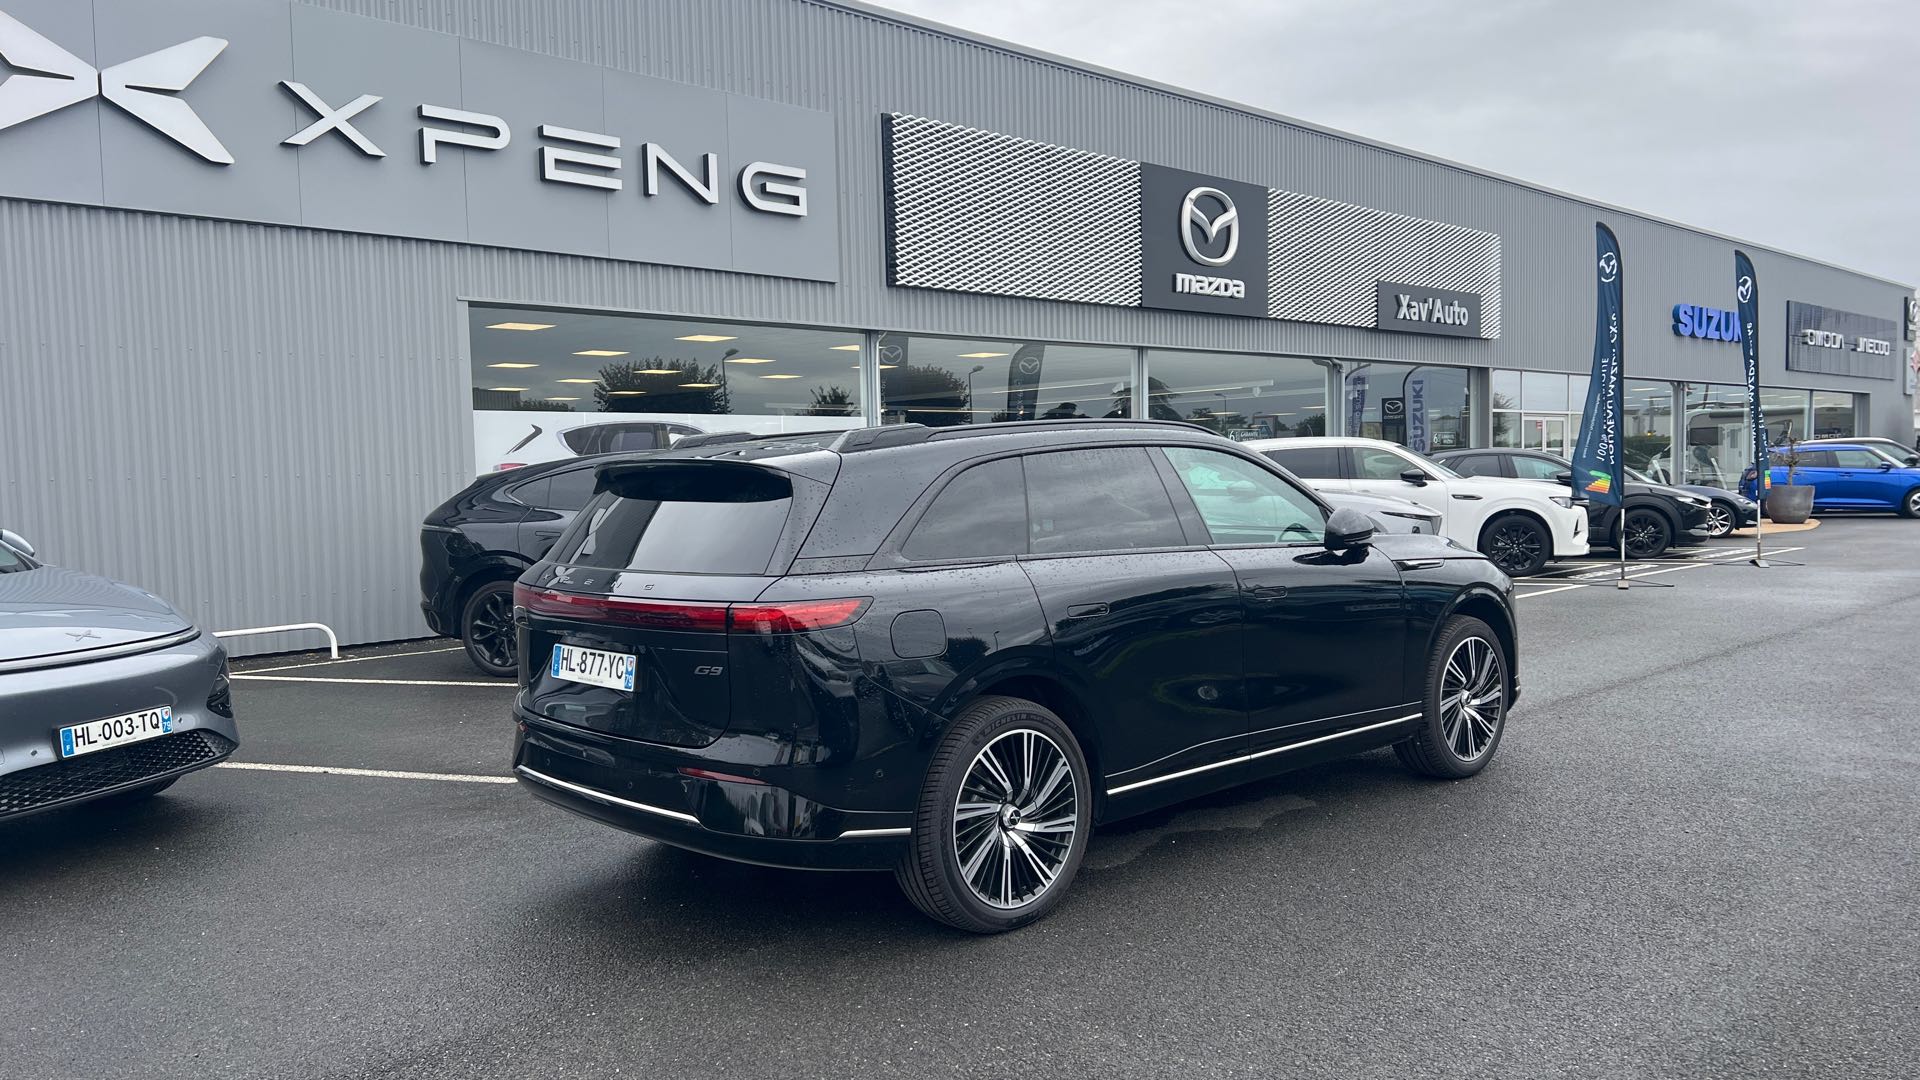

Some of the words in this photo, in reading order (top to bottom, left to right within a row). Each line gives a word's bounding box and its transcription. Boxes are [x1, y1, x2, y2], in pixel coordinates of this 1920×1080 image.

[279, 80, 808, 216] XPENG
[1396, 293, 1469, 326] Xav'Auto
[1674, 303, 1743, 343] SUZUK
[1411, 379, 1426, 452] SUZUKI
[560, 647, 625, 680] HL-877-YC
[624, 674, 633, 687] 79
[694, 665, 723, 676] G9
[74, 711, 160, 747] HL-003-TQ
[162, 721, 171, 731] 79
